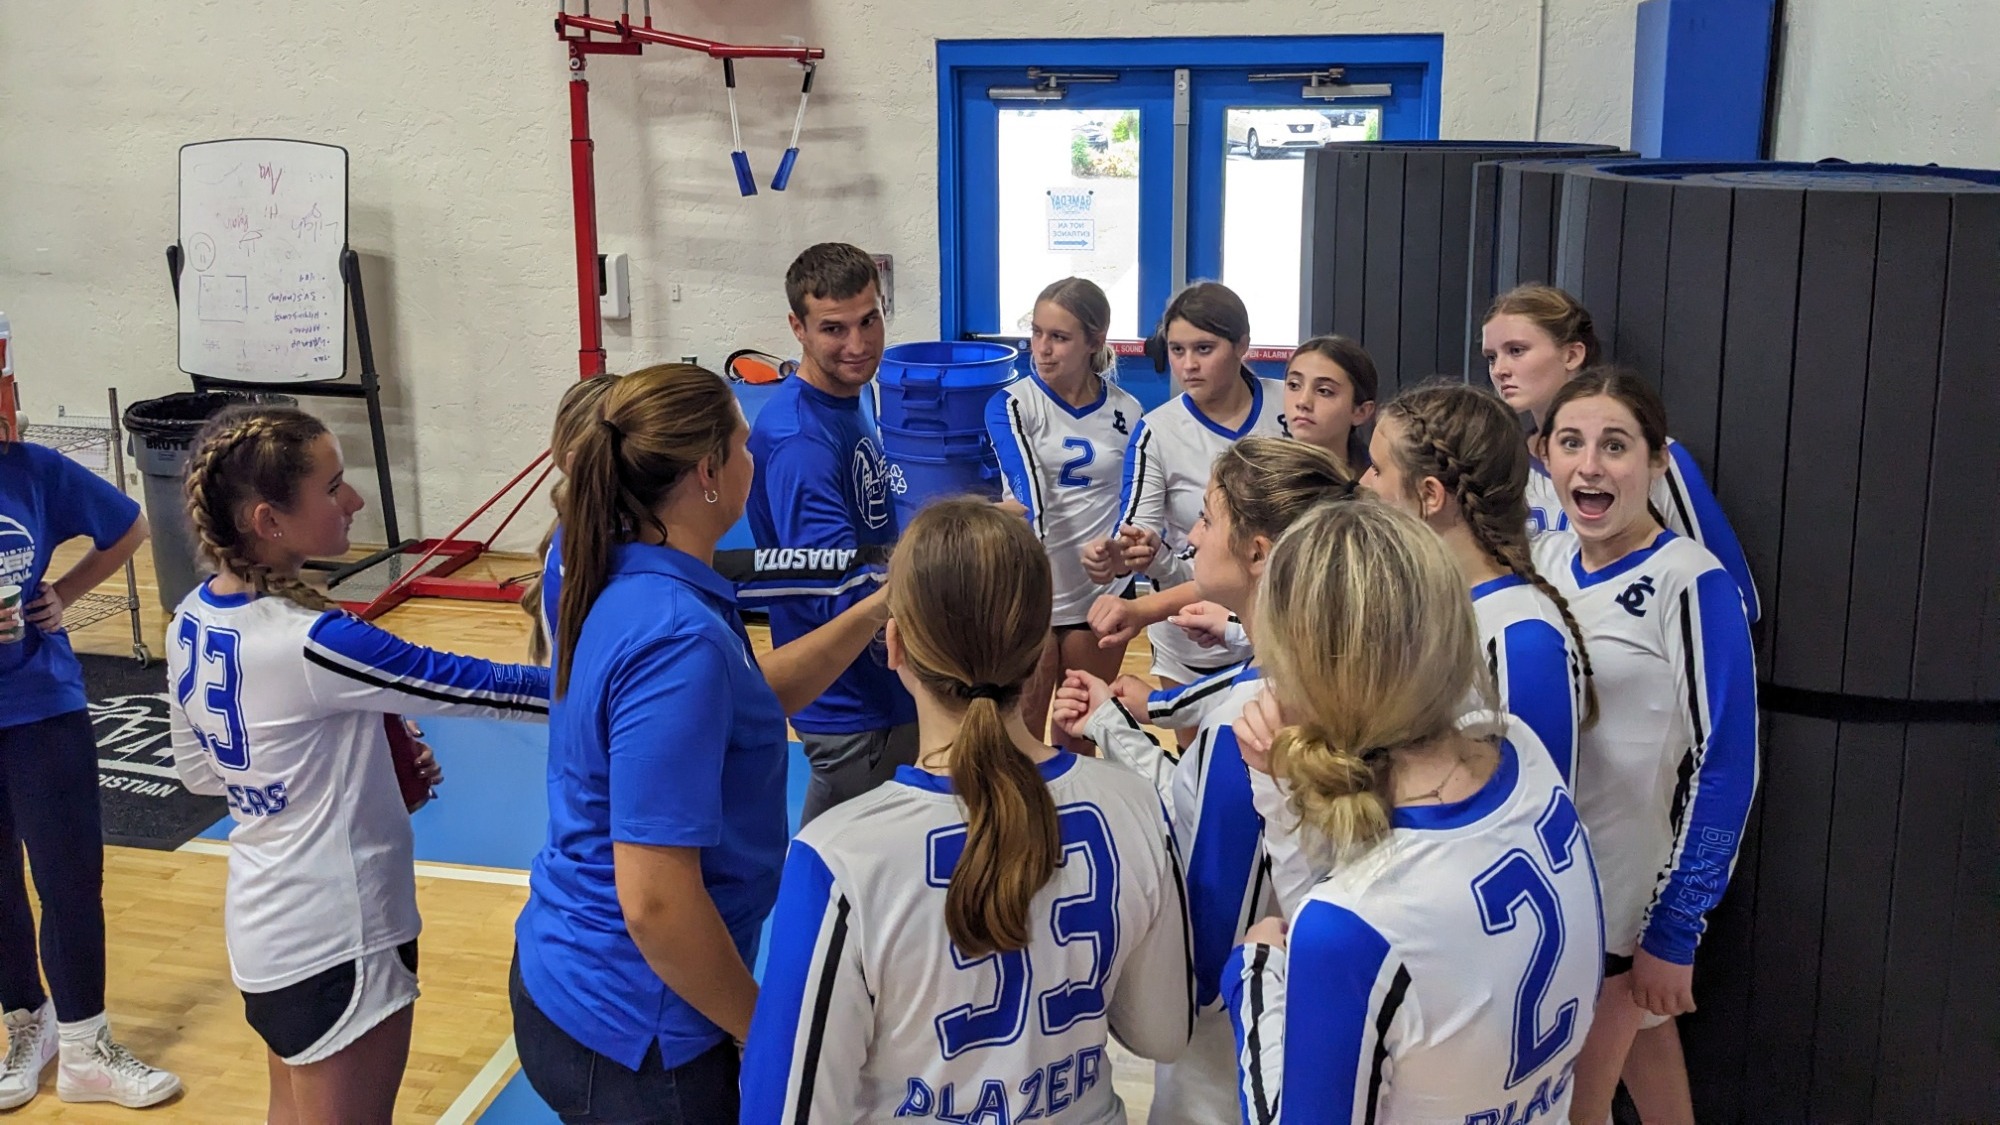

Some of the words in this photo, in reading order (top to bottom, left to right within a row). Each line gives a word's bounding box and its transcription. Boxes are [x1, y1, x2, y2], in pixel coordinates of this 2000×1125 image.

[1120, 344, 1144, 353] SOUND
[1058, 436, 1096, 487] 2
[177, 611, 250, 771] 23
